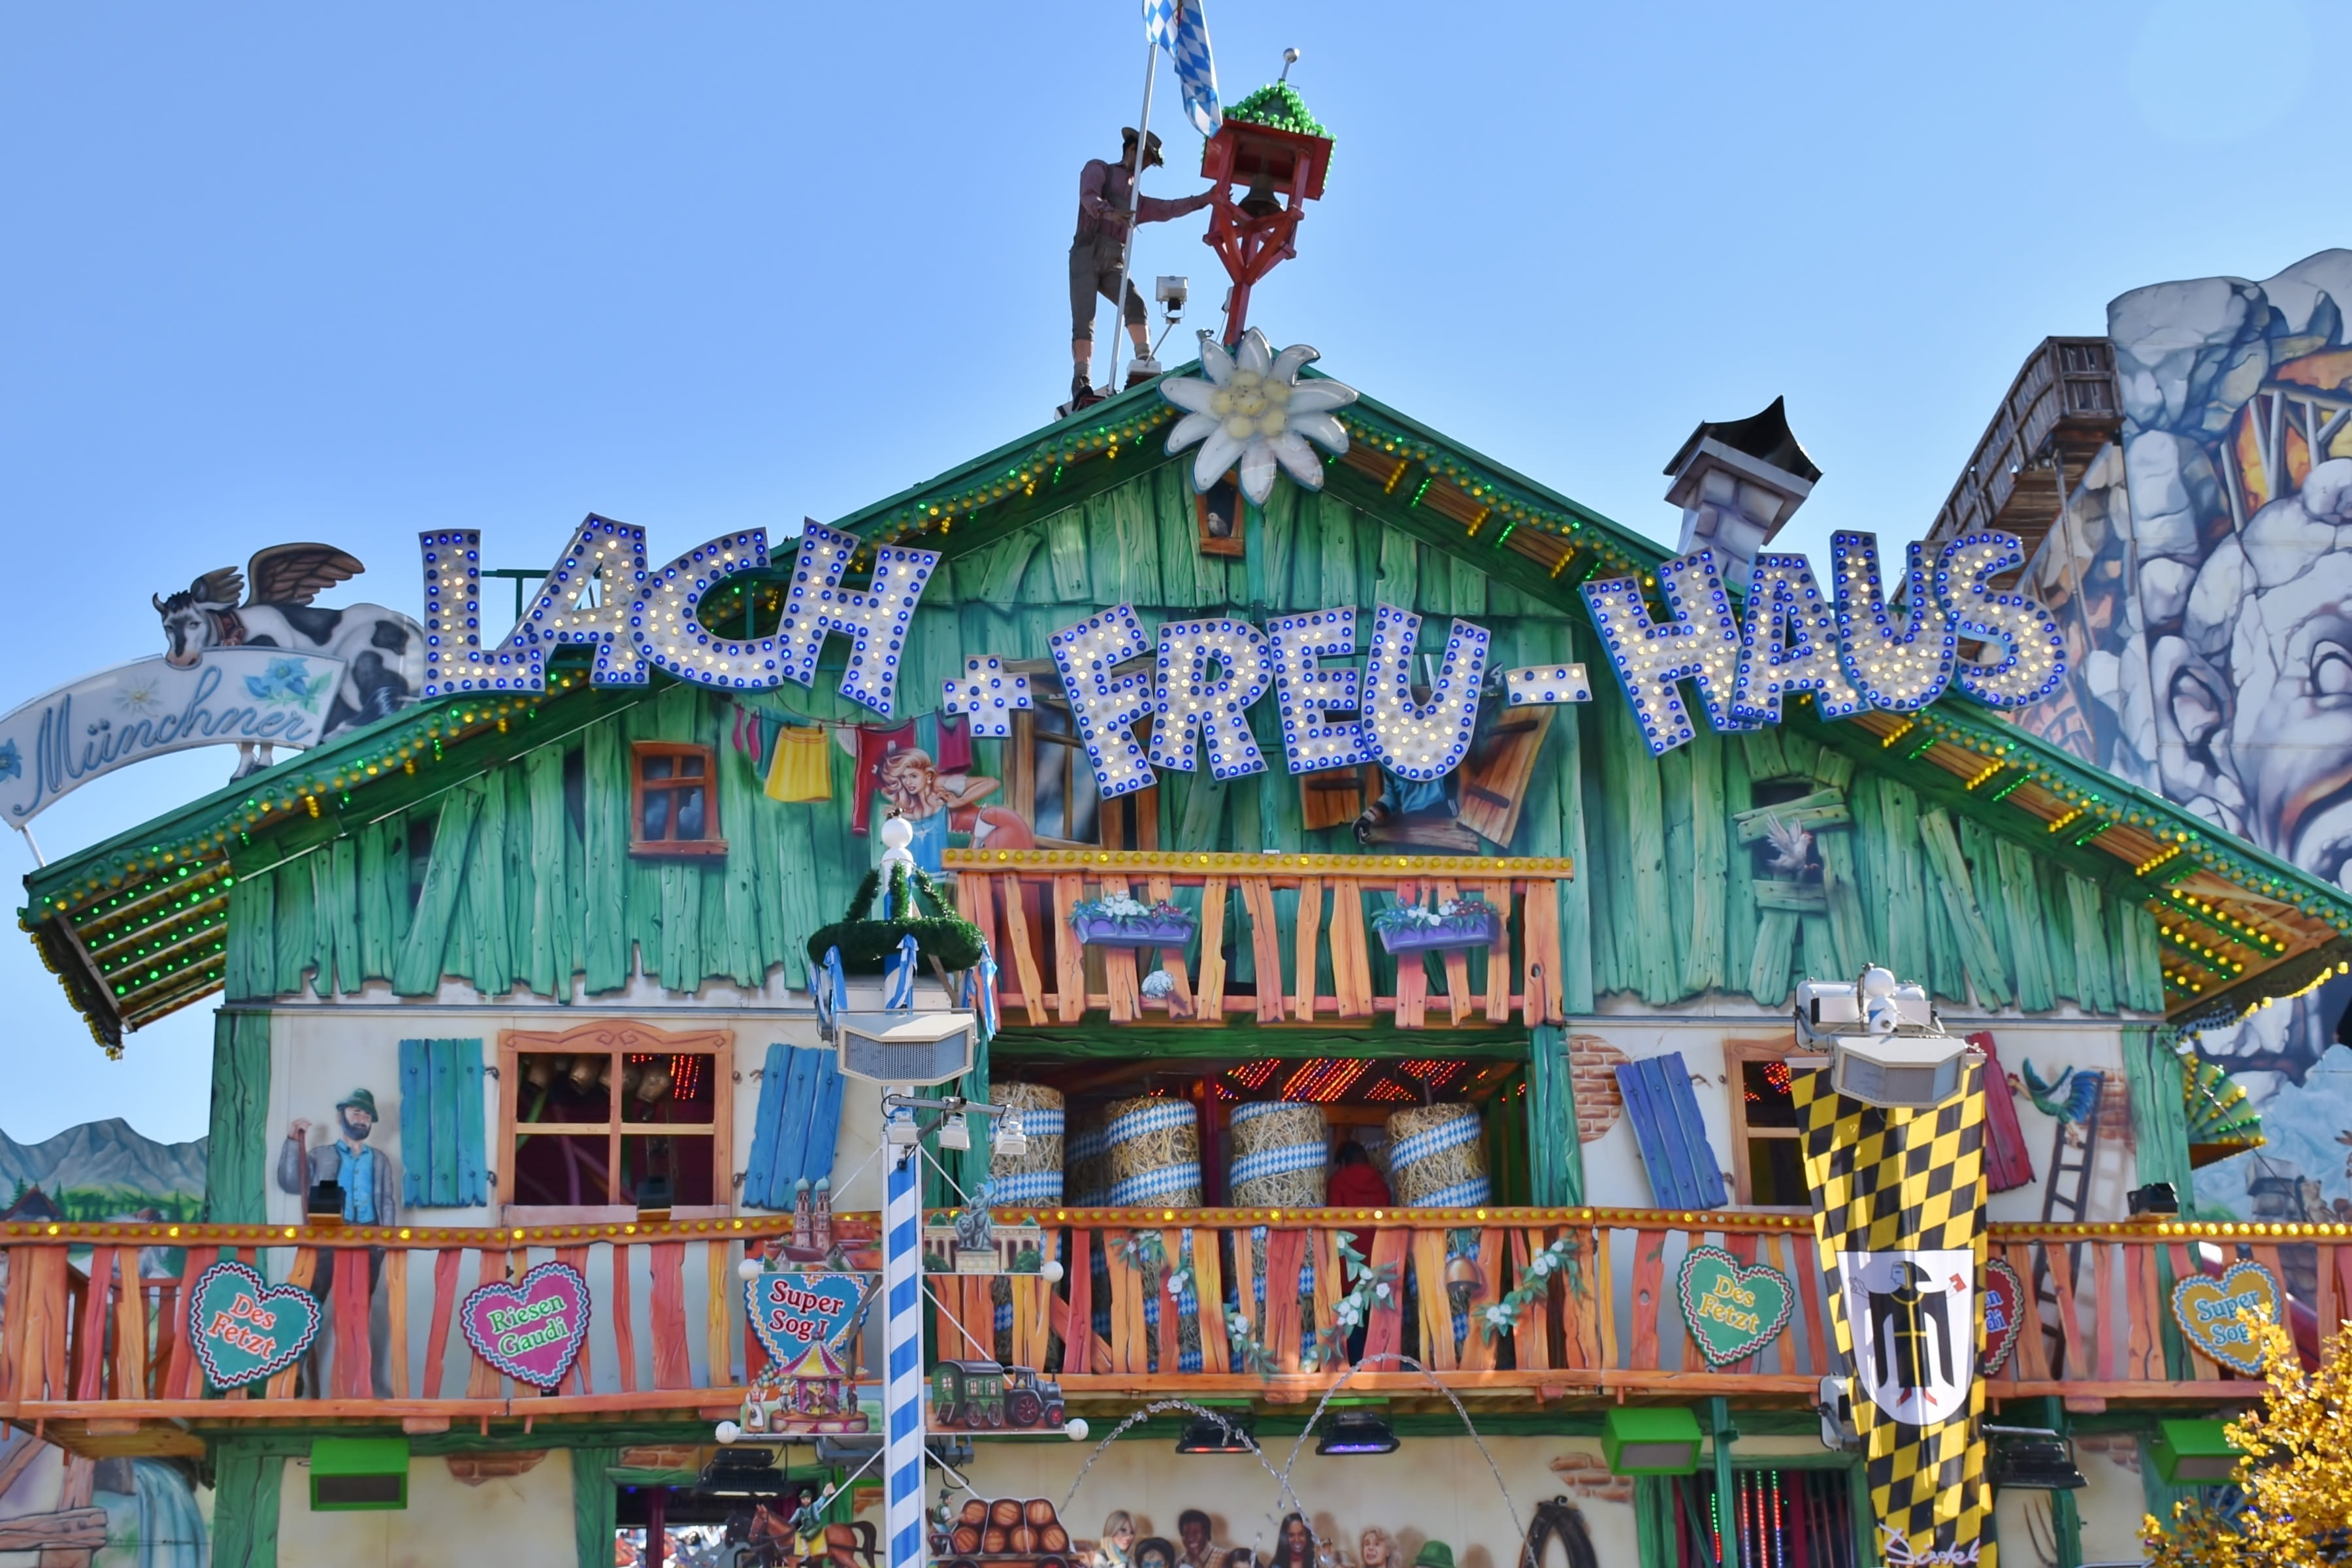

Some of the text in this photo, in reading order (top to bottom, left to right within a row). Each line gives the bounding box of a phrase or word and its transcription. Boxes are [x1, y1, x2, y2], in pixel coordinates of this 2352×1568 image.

[419, 512, 942, 720] LACH
[1579, 529, 2068, 759] HAUS
[13, 665, 315, 817] Münchner
[769, 1279, 845, 1316] Super
[1713, 1275, 1756, 1307] Des
[2195, 1291, 2260, 1321] Super
[228, 1293, 277, 1330] Des
[486, 1295, 568, 1335] Riesen
[1697, 1292, 1760, 1335] Fetzt
[207, 1311, 276, 1360] Fetzt
[498, 1316, 570, 1357] Gaudi
